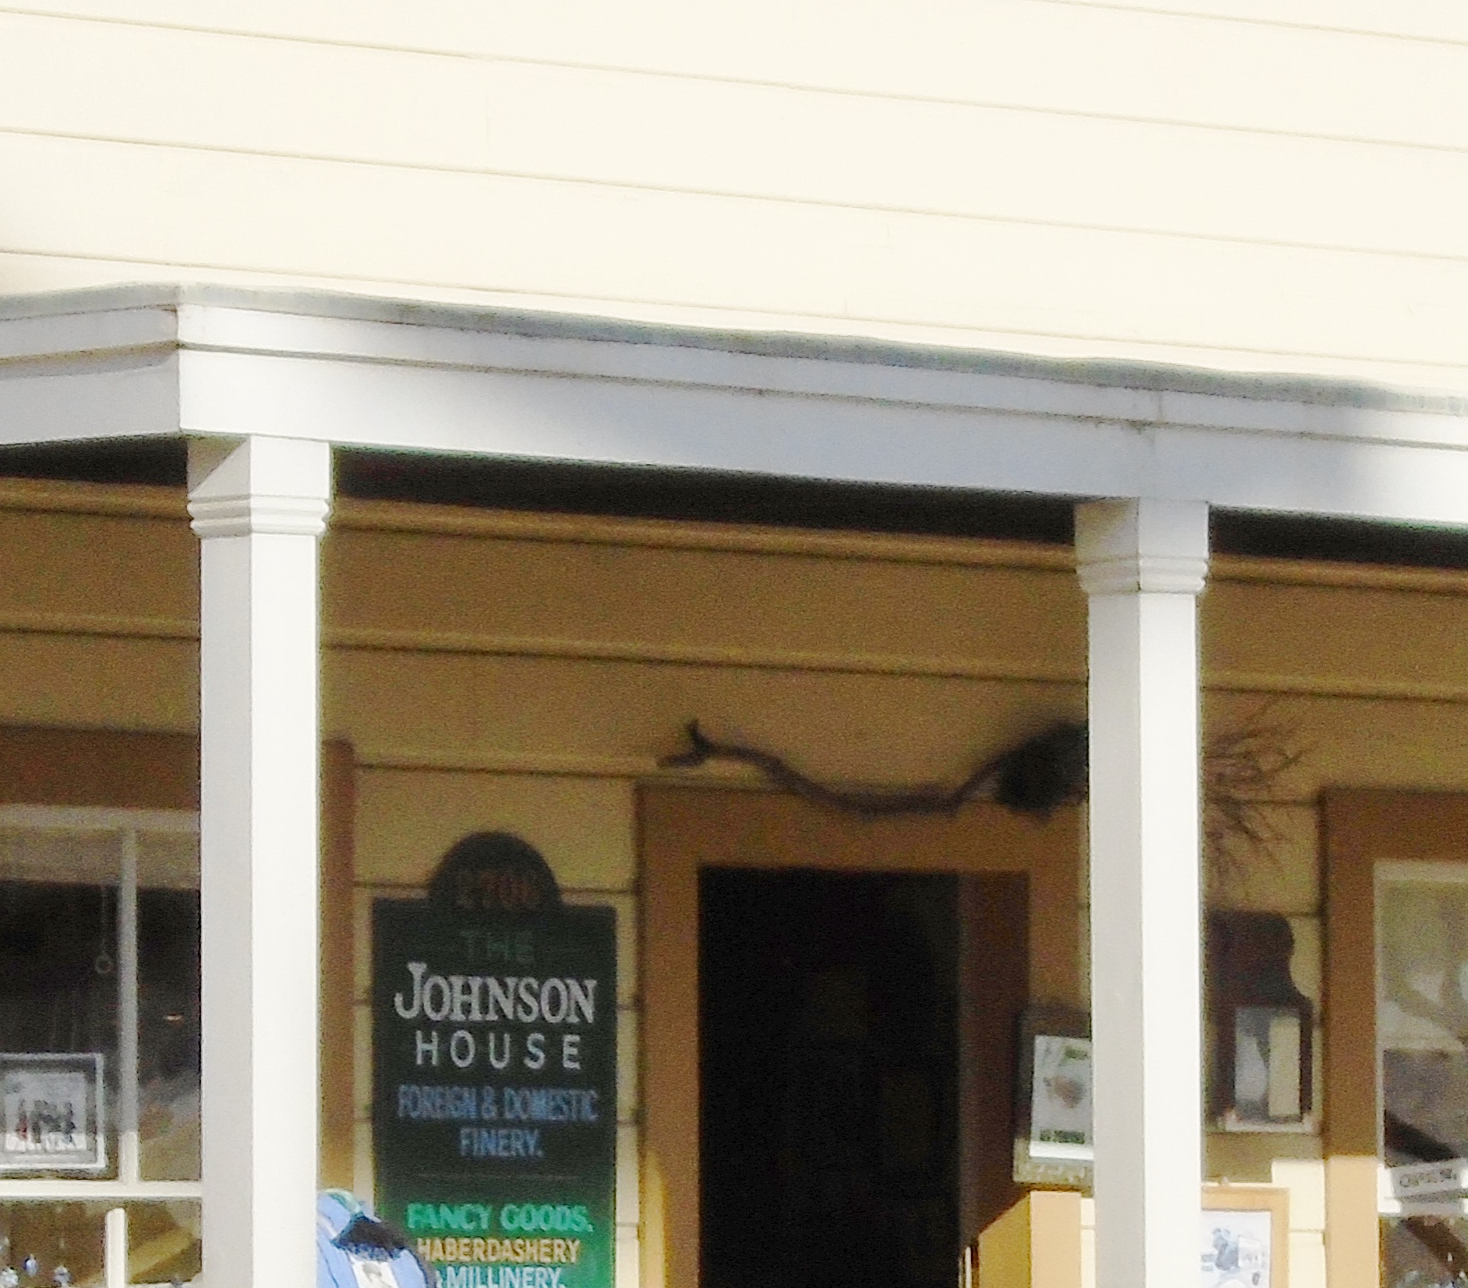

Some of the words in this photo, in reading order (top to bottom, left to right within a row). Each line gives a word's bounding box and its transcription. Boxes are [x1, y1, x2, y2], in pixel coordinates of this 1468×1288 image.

[394, 961, 597, 1024] JOHNSON
[416, 1030, 581, 1069] HOUSE
[398, 1084, 477, 1119] FOREIGN
[482, 1085, 497, 1120] &
[503, 1086, 599, 1122] DOMESTIC
[407, 1203, 492, 1230] FANCY
[417, 1237, 581, 1264] HABERDASHERY
